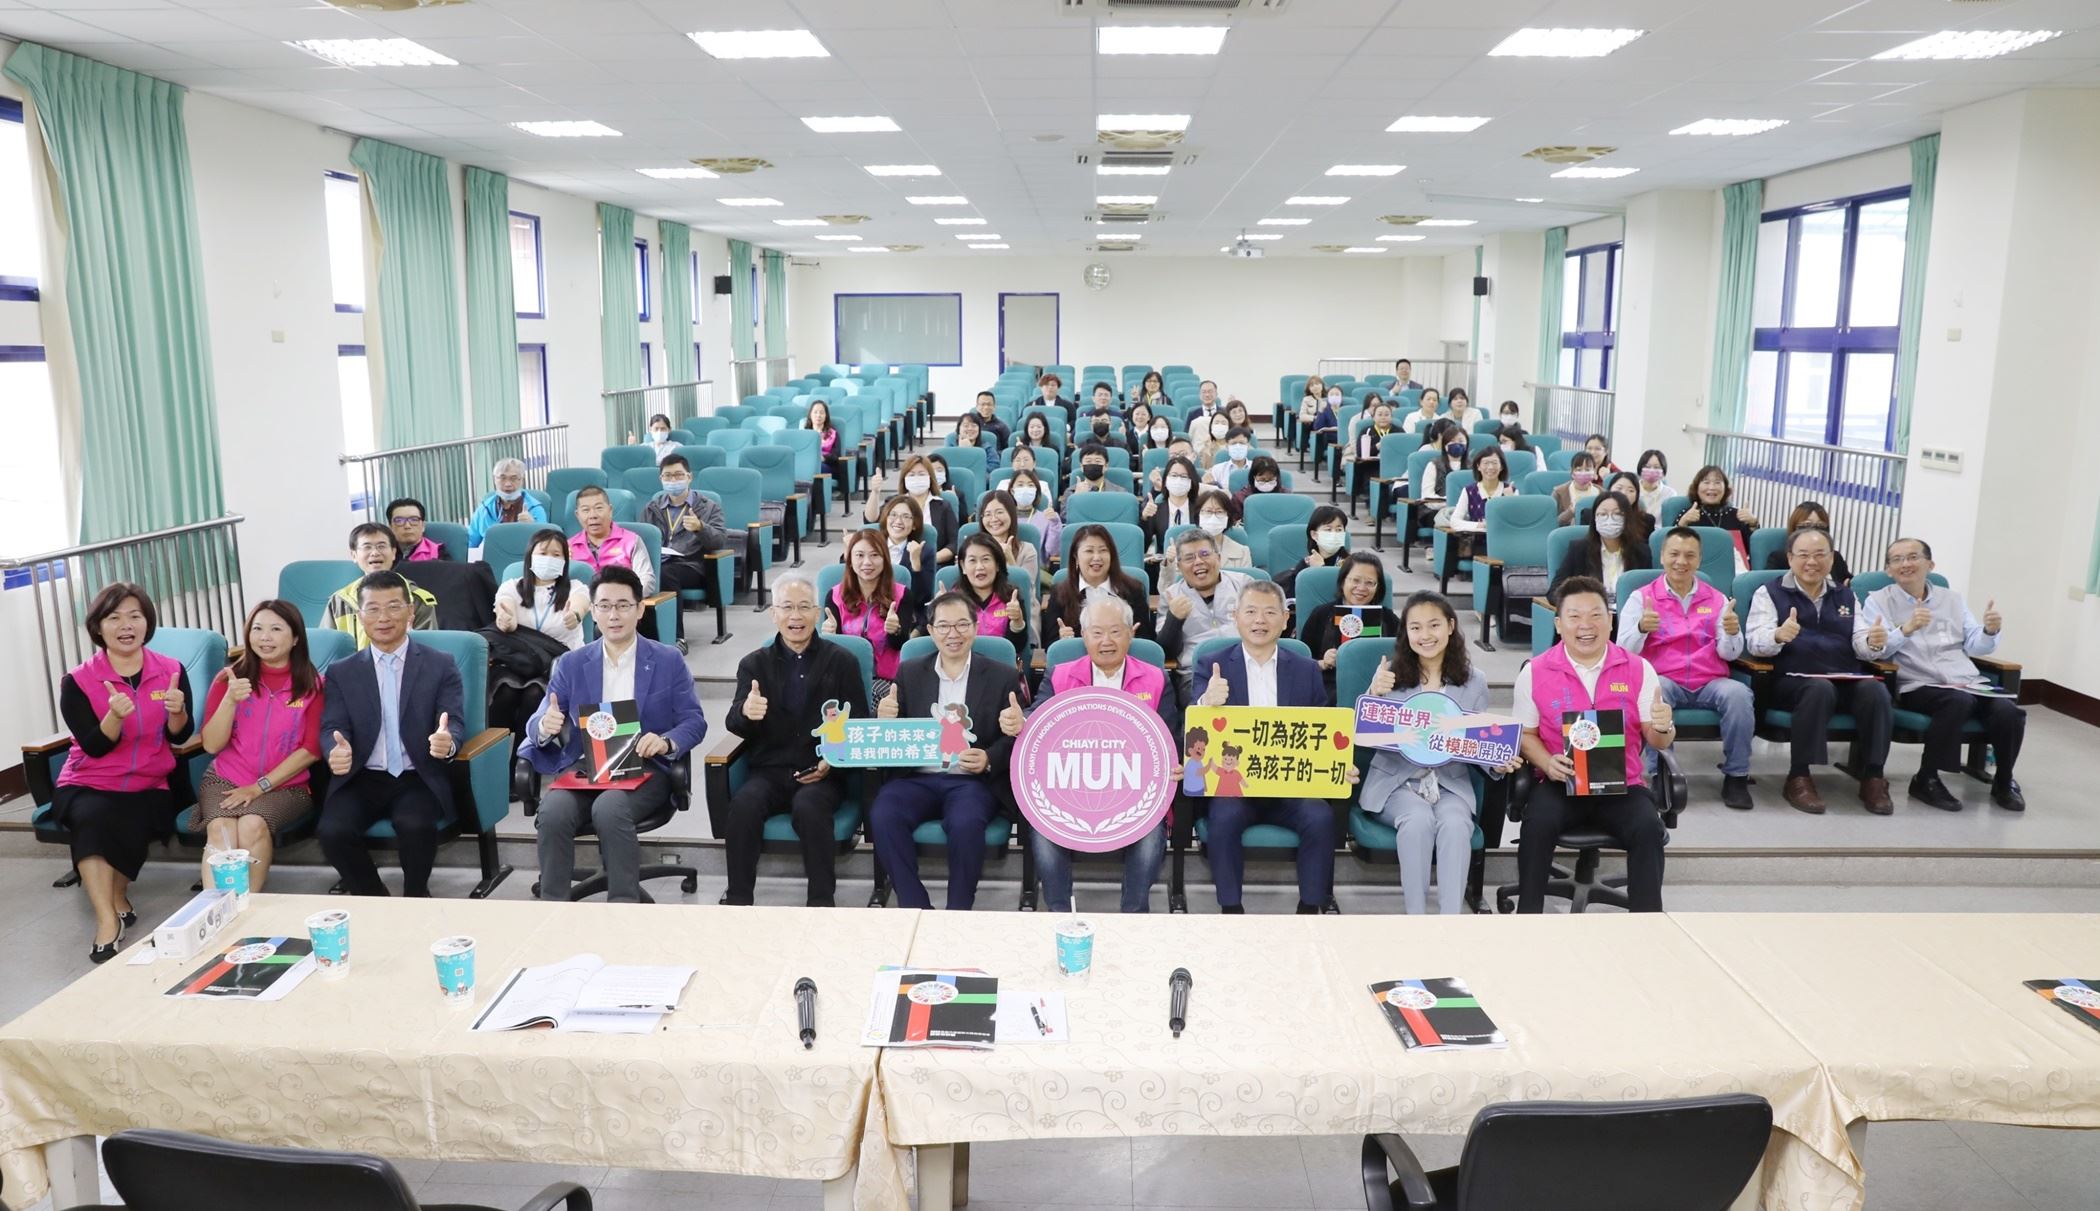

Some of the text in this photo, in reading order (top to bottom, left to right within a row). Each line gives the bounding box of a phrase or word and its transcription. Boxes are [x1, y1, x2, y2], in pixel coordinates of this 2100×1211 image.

[1361, 702, 1432, 729] 連結世界
[847, 726, 925, 743] 孩子的未來
[1028, 703, 1161, 778] CHIAYI CITY MODEL UNITED NATIONS DEVELOPMENT ASSOCIATION
[1062, 739, 1127, 749] CHIAYI CITY
[1233, 719, 1328, 751] 一切為孩子
[1429, 734, 1514, 761] 從模聯開始
[850, 744, 939, 760] 是我們的希望
[1047, 752, 1141, 790] MUN
[1246, 754, 1346, 785] 為孩子的一切
